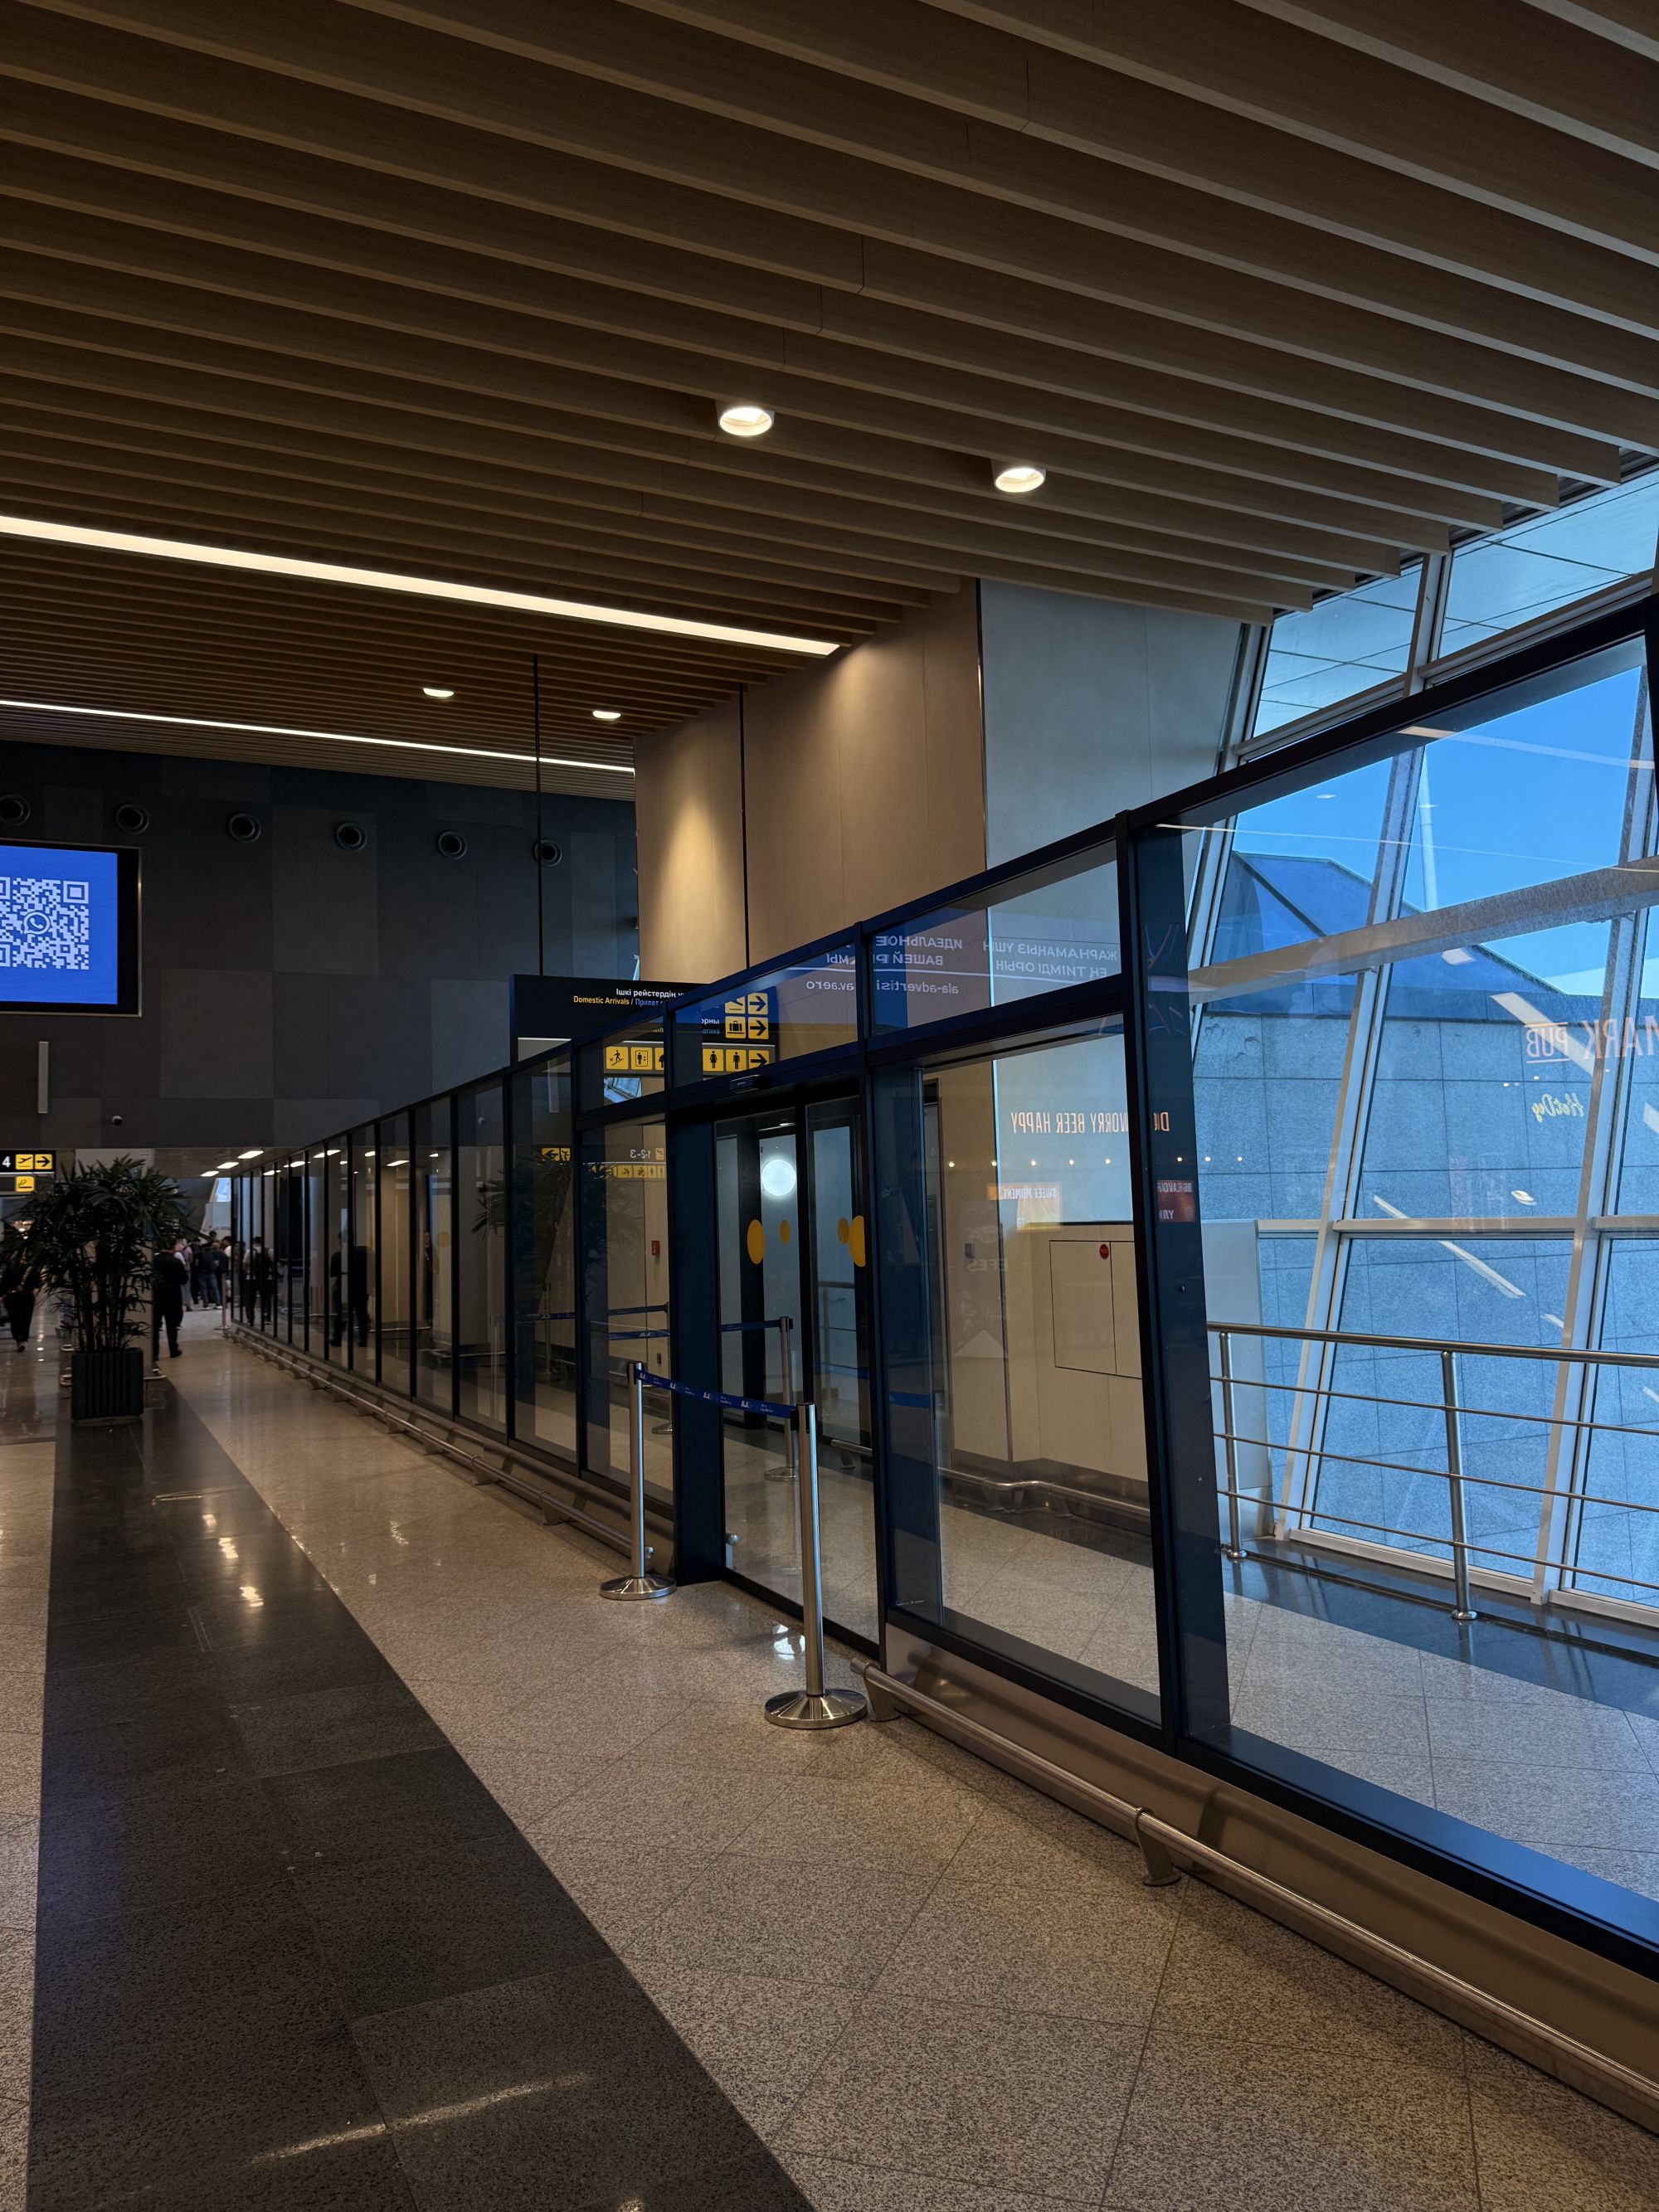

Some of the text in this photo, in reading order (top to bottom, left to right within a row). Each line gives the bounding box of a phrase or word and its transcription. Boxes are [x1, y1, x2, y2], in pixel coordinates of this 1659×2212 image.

[615, 988, 632, 996] Ішкі
[573, 995, 604, 1004] Domestic
[605, 996, 630, 1005] Arrivals
[635, 998, 659, 1007] Прилет
[2, 1155, 12, 1168] 4
